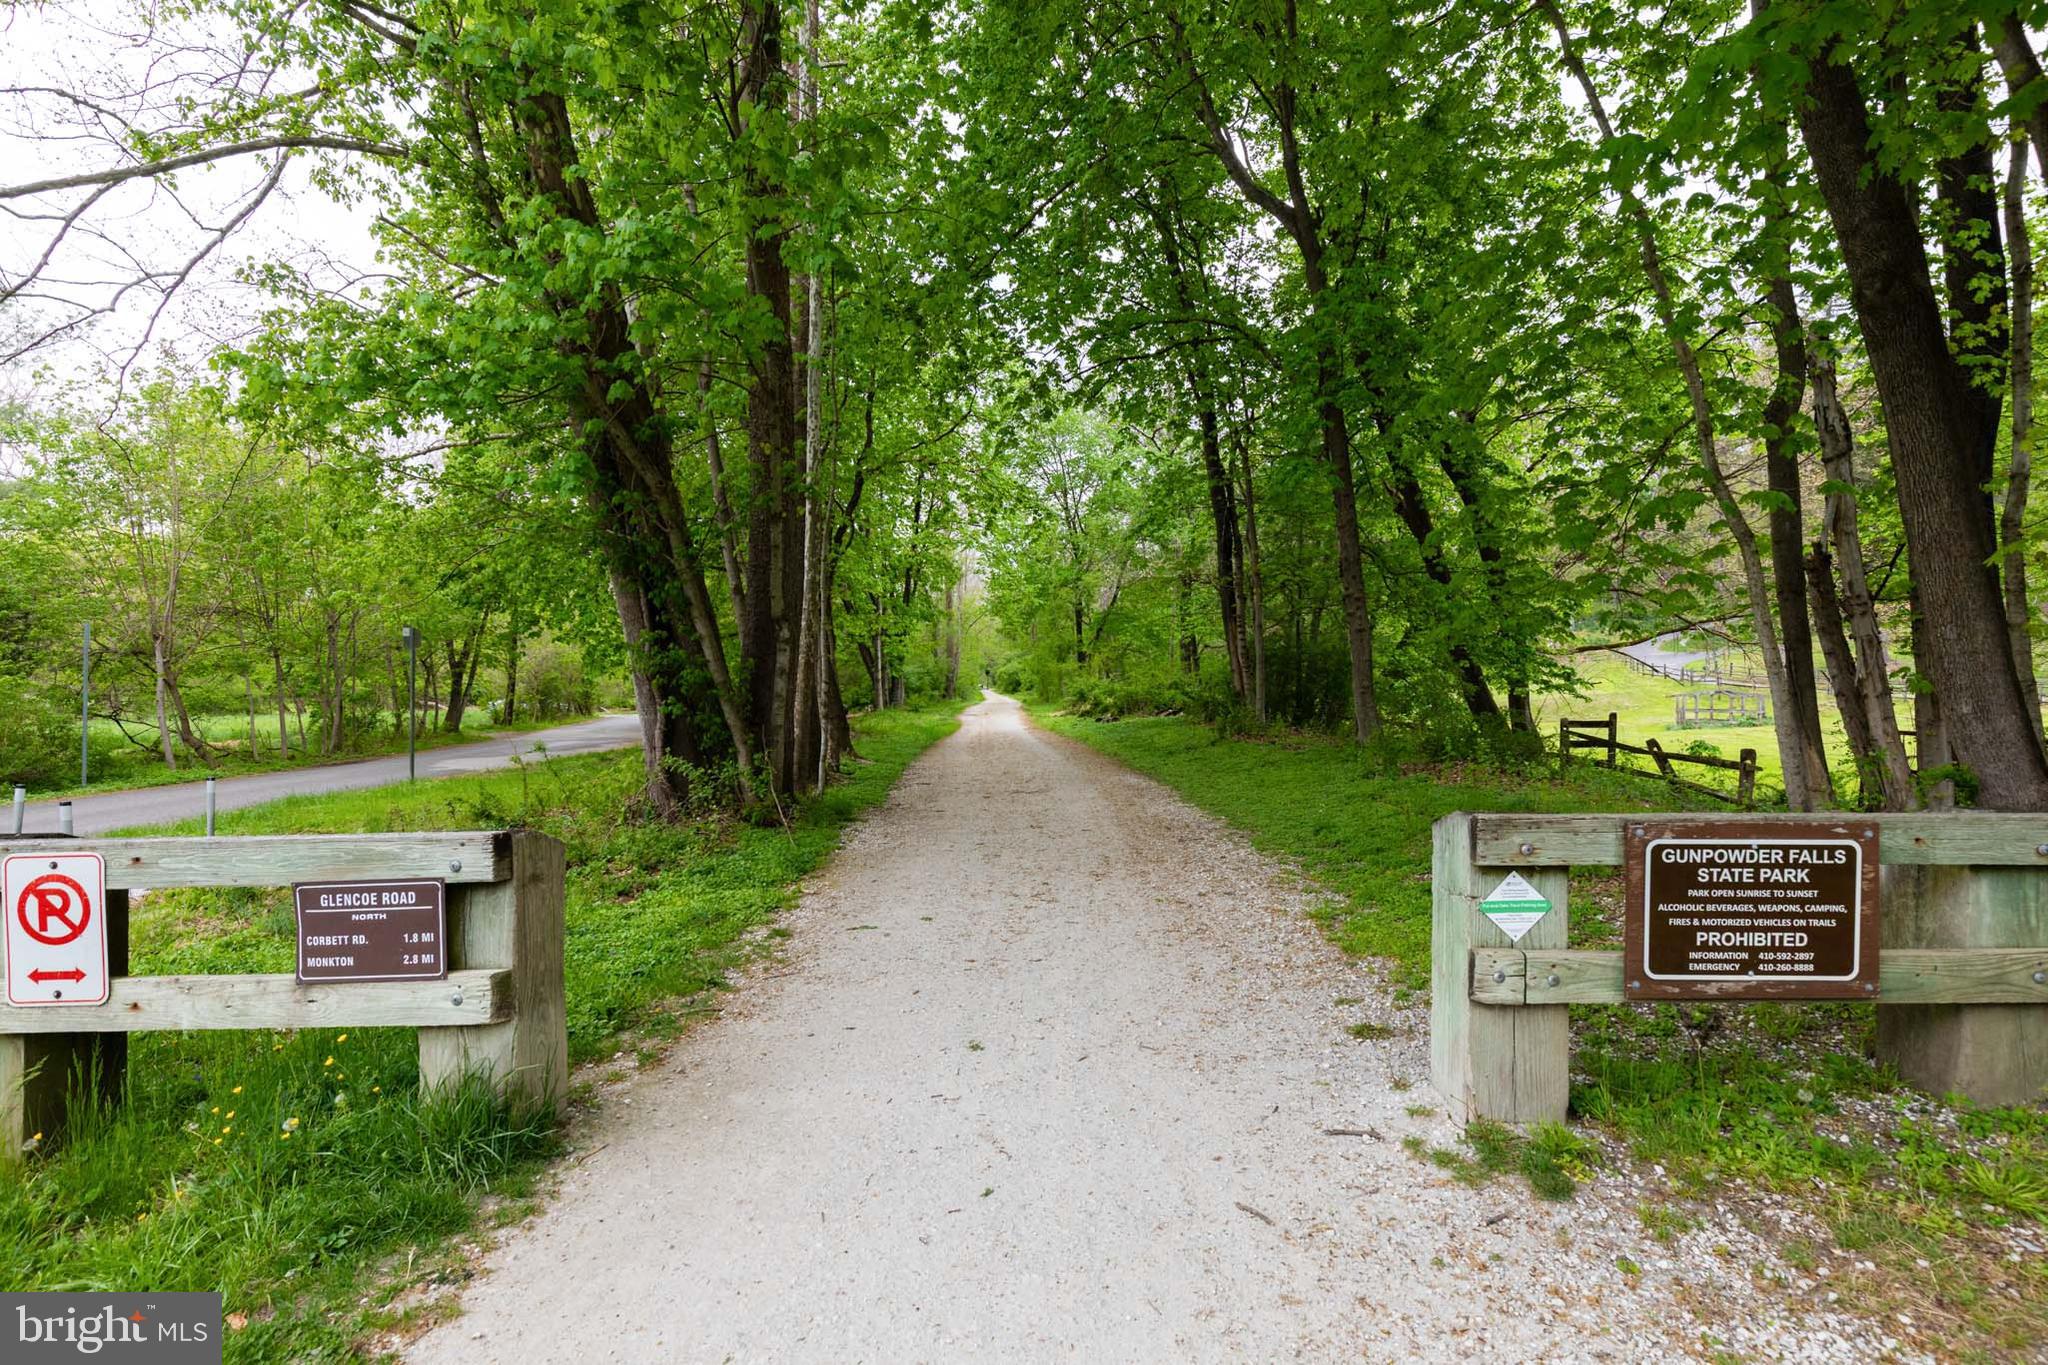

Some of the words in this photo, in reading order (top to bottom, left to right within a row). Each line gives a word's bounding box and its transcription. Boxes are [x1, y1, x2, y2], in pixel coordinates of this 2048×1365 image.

[1661, 849, 1784, 864] GUNPOWDER
[1789, 849, 1847, 864] FALLS
[1697, 868, 1755, 883] STATE
[1760, 868, 1810, 883] PARK
[320, 893, 378, 907] GLENCOE
[382, 891, 416, 905] ROAD
[1687, 889, 1710, 898] PARK
[1711, 889, 1735, 898] OPEN
[1736, 889, 1772, 898] SUNRISE
[1773, 889, 1785, 898] TO
[1786, 889, 1818, 898] SUNSET
[1657, 903, 1705, 912] ALCOHOLIC
[1706, 903, 1757, 913] BEVERAGES,
[1758, 904, 1803, 914] WEAPONS,
[1804, 904, 1848, 914] CAMPING,
[351, 913, 387, 921] NORTH
[1668, 918, 1691, 926] FIRES
[1692, 918, 1700, 926] &
[1701, 918, 1752, 927] MOTORIZED
[1753, 918, 1792, 927] VEHICLES
[1793, 918, 1807, 927] ON
[1808, 918, 1837, 927] TRAILS
[306, 935, 350, 946] CORBETT
[352, 935, 369, 945] RD.
[403, 933, 419, 943] 1.8
[421, 932, 434, 943] MI
[1696, 932, 1808, 947] PROHIBITED
[307, 956, 354, 968] MONKTON
[403, 954, 419, 965] 2.8
[421, 954, 434, 964] MI
[1689, 951, 1749, 960] INFORMATION
[1758, 952, 1815, 961] 410-592-2897
[1689, 963, 1740, 971] EMERGENCY
[1758, 963, 1815, 972] 410-260-8888
